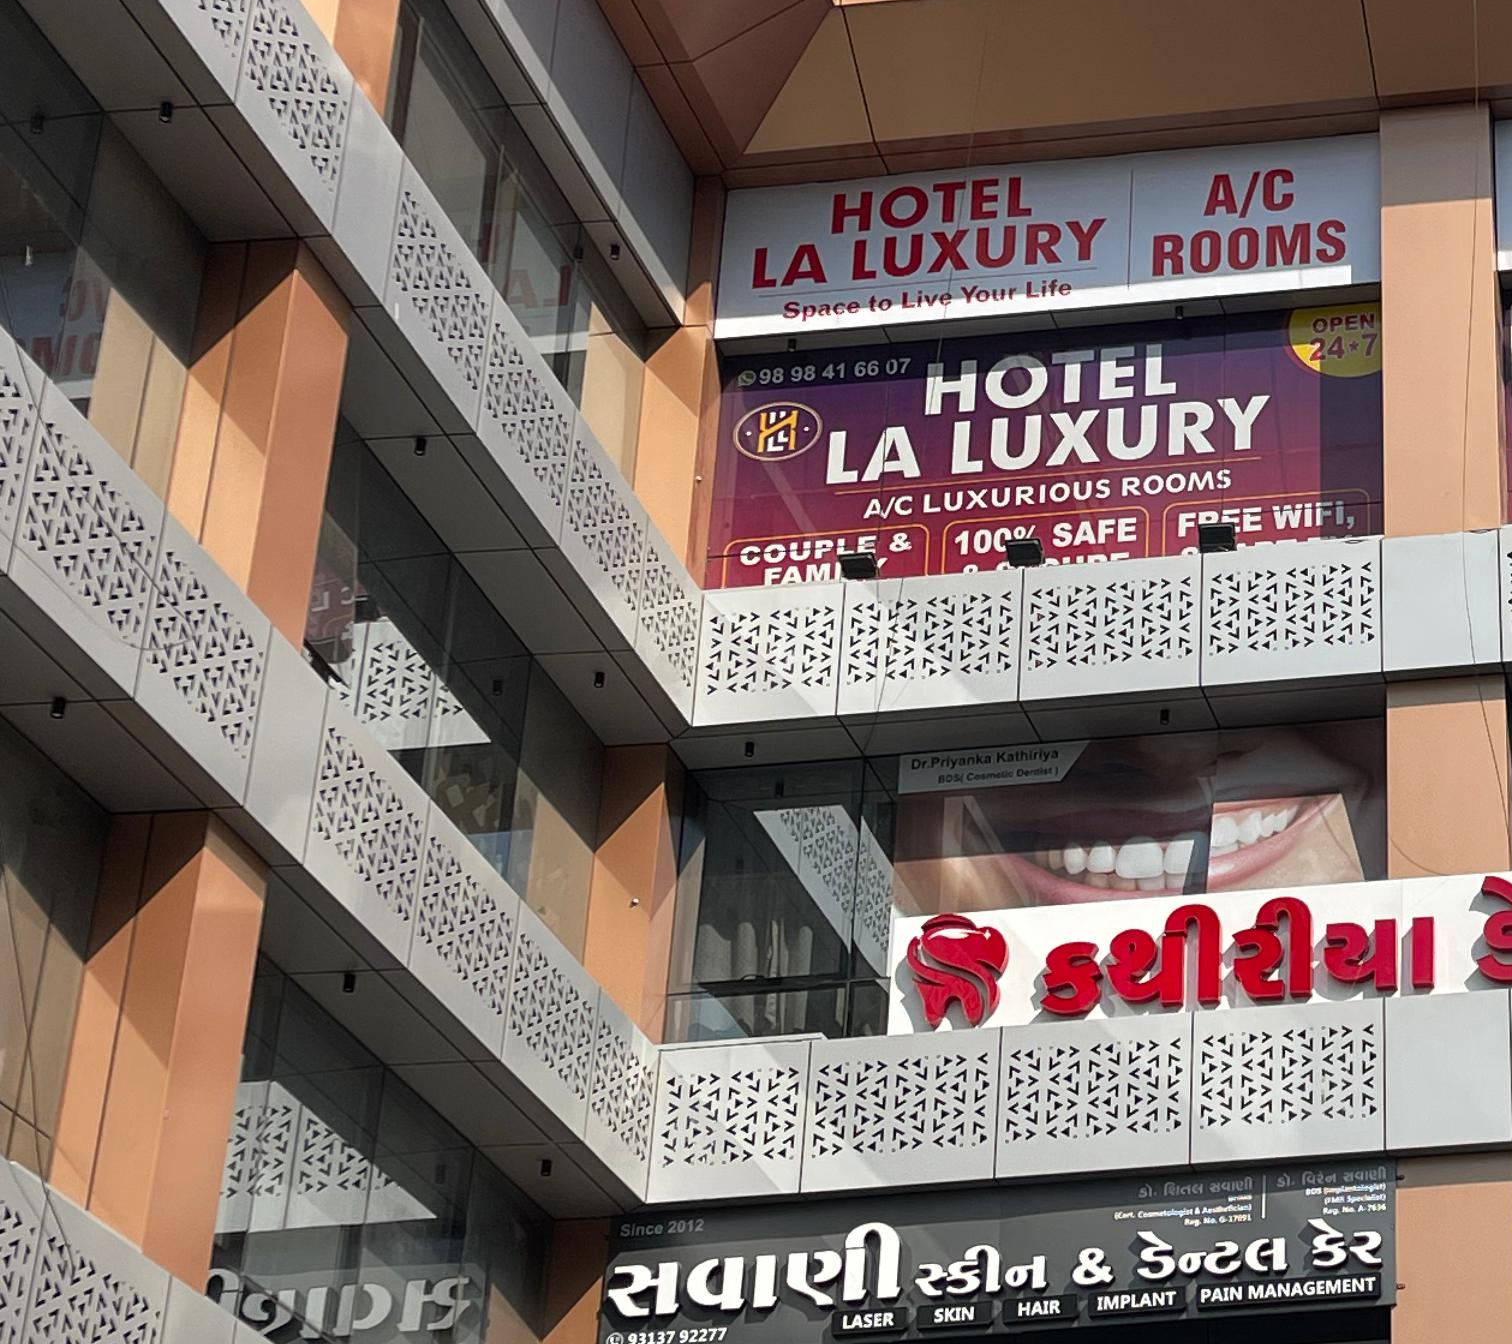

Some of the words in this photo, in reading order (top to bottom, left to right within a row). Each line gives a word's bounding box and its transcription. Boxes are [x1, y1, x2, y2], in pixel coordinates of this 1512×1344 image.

[831, 176, 1033, 235] HOTEL
[1204, 168, 1294, 219] A/C
[752, 243, 828, 290] LA
[852, 218, 1108, 281] LUXURY
[1152, 219, 1347, 277] ROOMS
[782, 300, 860, 322] Space
[869, 295, 893, 313] to
[901, 290, 953, 309] Live
[960, 284, 1018, 304] Your
[1025, 278, 1073, 298] Life
[1312, 312, 1376, 334] OPEN
[924, 343, 1177, 416] HOTEL
[826, 426, 921, 485] LA
[951, 395, 1270, 475] LUXURY
[863, 495, 913, 519] A/C
[923, 478, 1111, 514] LUXURIOUS
[1121, 468, 1233, 498] ROOMS
[1053, 517, 1137, 548] SAFE
[739, 534, 878, 566] COUPLE
[996, 748, 1058, 764] Kathiriya
[1040, 896, 1435, 1016] કથીરીયા
[620, 1223, 663, 1238] Since
[667, 1219, 705, 1234] 2012
[608, 1221, 902, 1318] સવાણી
[915, 1244, 1048, 1297] સ્કીન
[1072, 1247, 1116, 1287] &
[1136, 1230, 1289, 1281] ડેન્ટલ
[1307, 1218, 1384, 1268] કેર
[1096, 1291, 1177, 1311] IMPLANT
[1200, 1285, 1243, 1303] PAIN
[1248, 1277, 1377, 1299] MANAGEMENT
[842, 1312, 895, 1329] LASER
[933, 1306, 975, 1323] SKIN
[1017, 1300, 1061, 1316] HAIR
[679, 1327, 728, 1344] 92277
